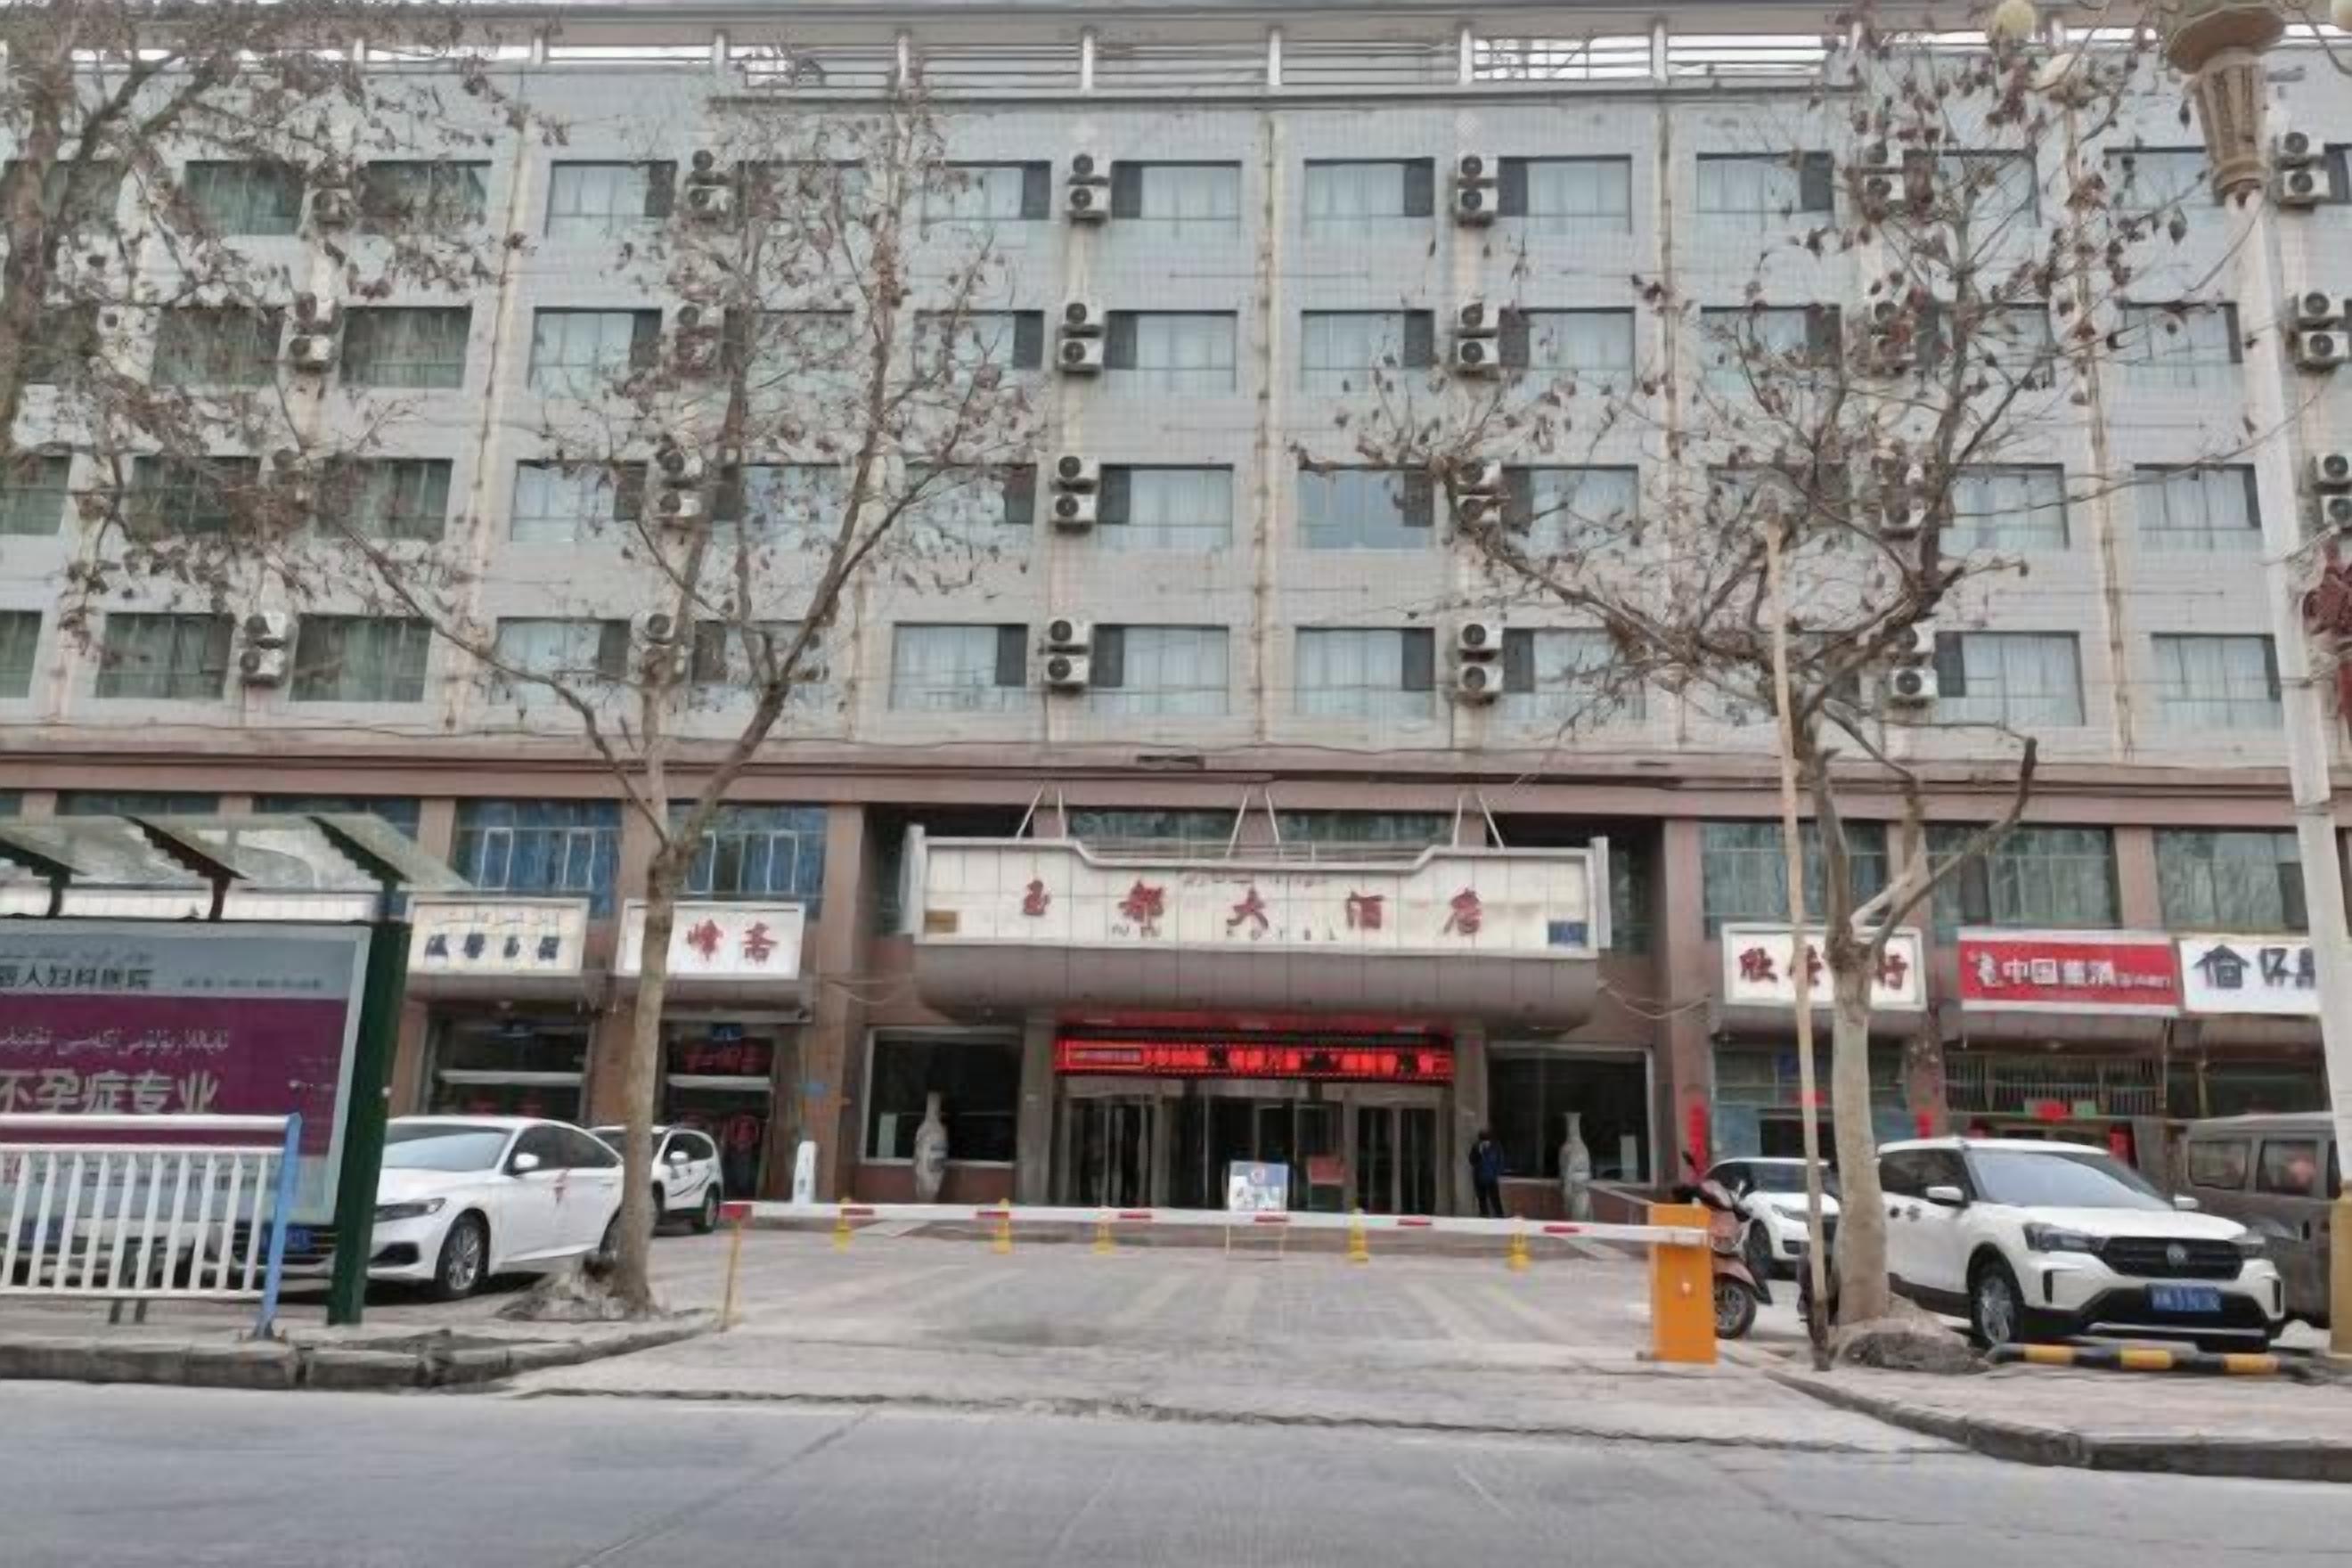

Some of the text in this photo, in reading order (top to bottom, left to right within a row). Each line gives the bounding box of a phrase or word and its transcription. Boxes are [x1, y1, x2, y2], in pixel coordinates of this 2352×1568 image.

[0, 1067, 220, 1114] 不孕症专业
